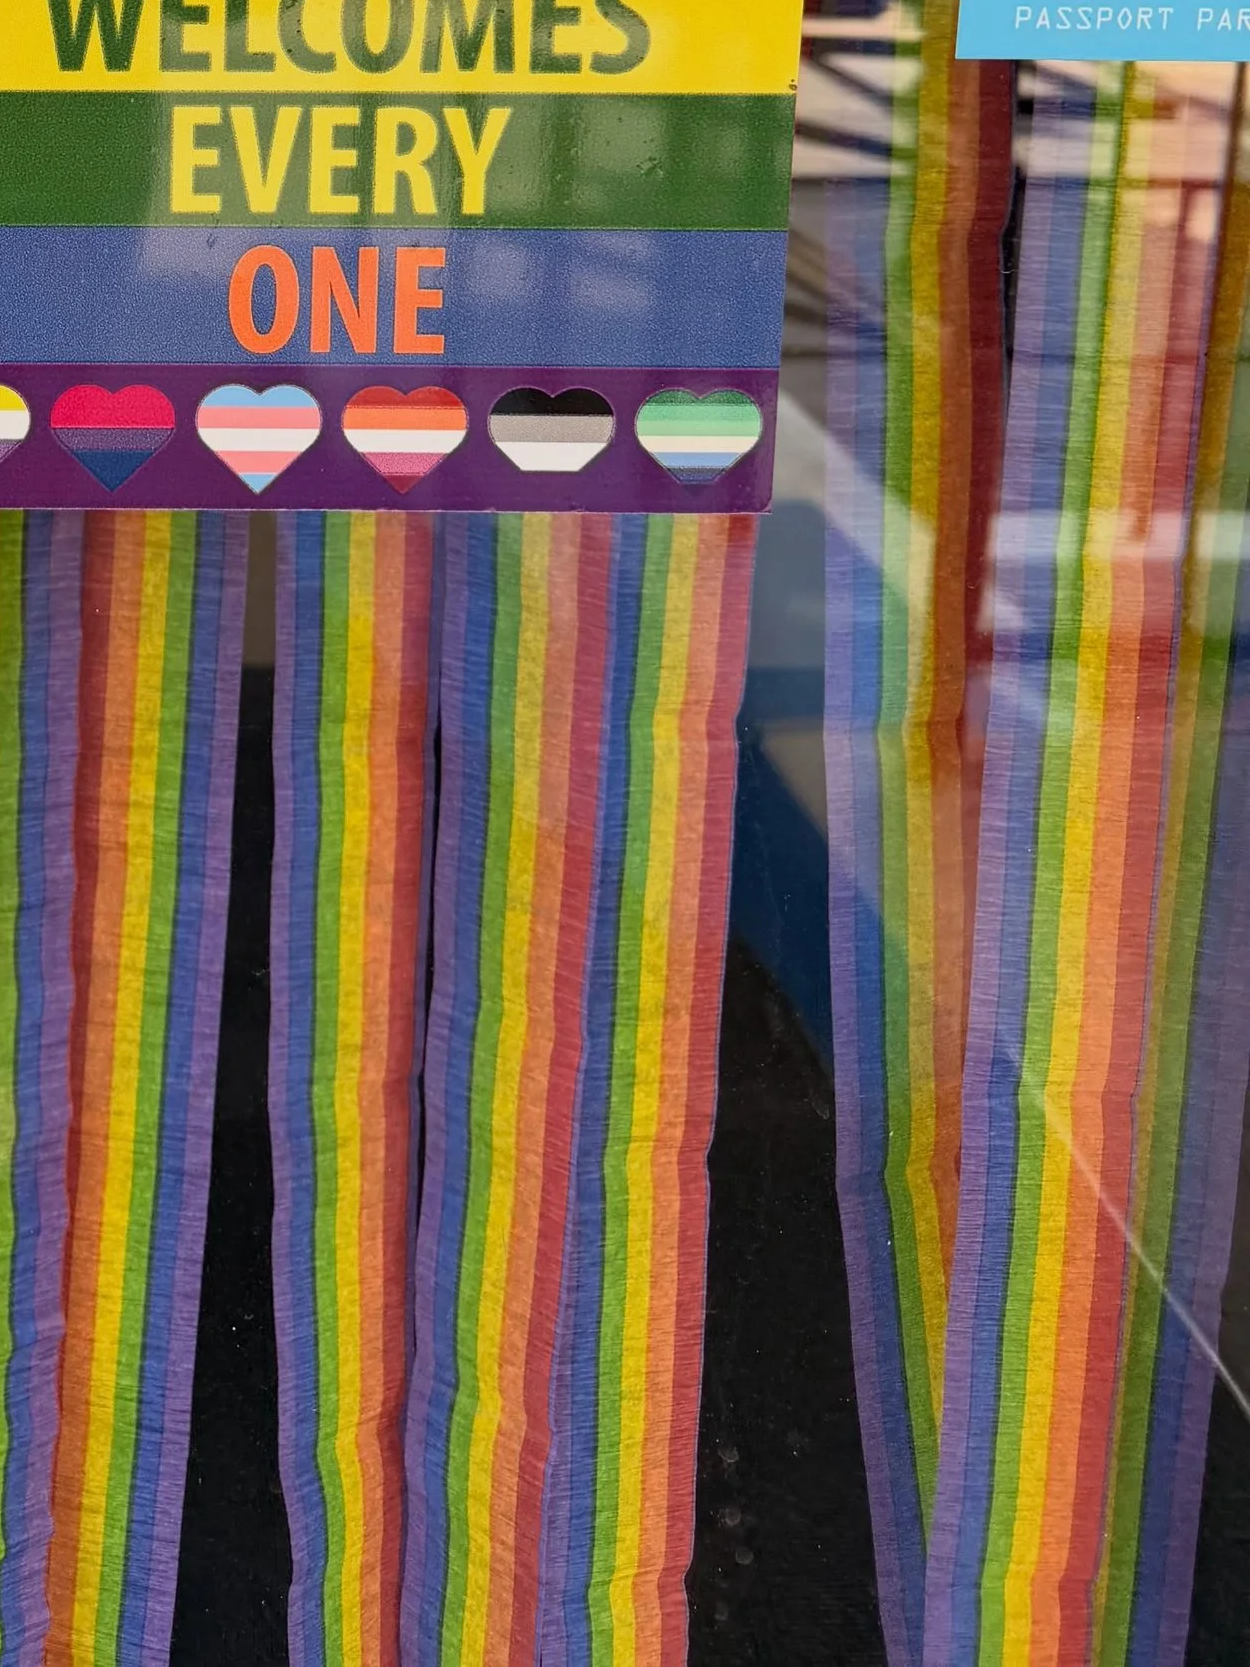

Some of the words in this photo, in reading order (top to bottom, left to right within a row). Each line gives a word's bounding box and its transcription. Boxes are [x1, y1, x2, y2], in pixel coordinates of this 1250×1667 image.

[1015, 6, 1174, 30] PASSPORT
[169, 106, 511, 216] EVERY
[228, 245, 447, 355] ONE
